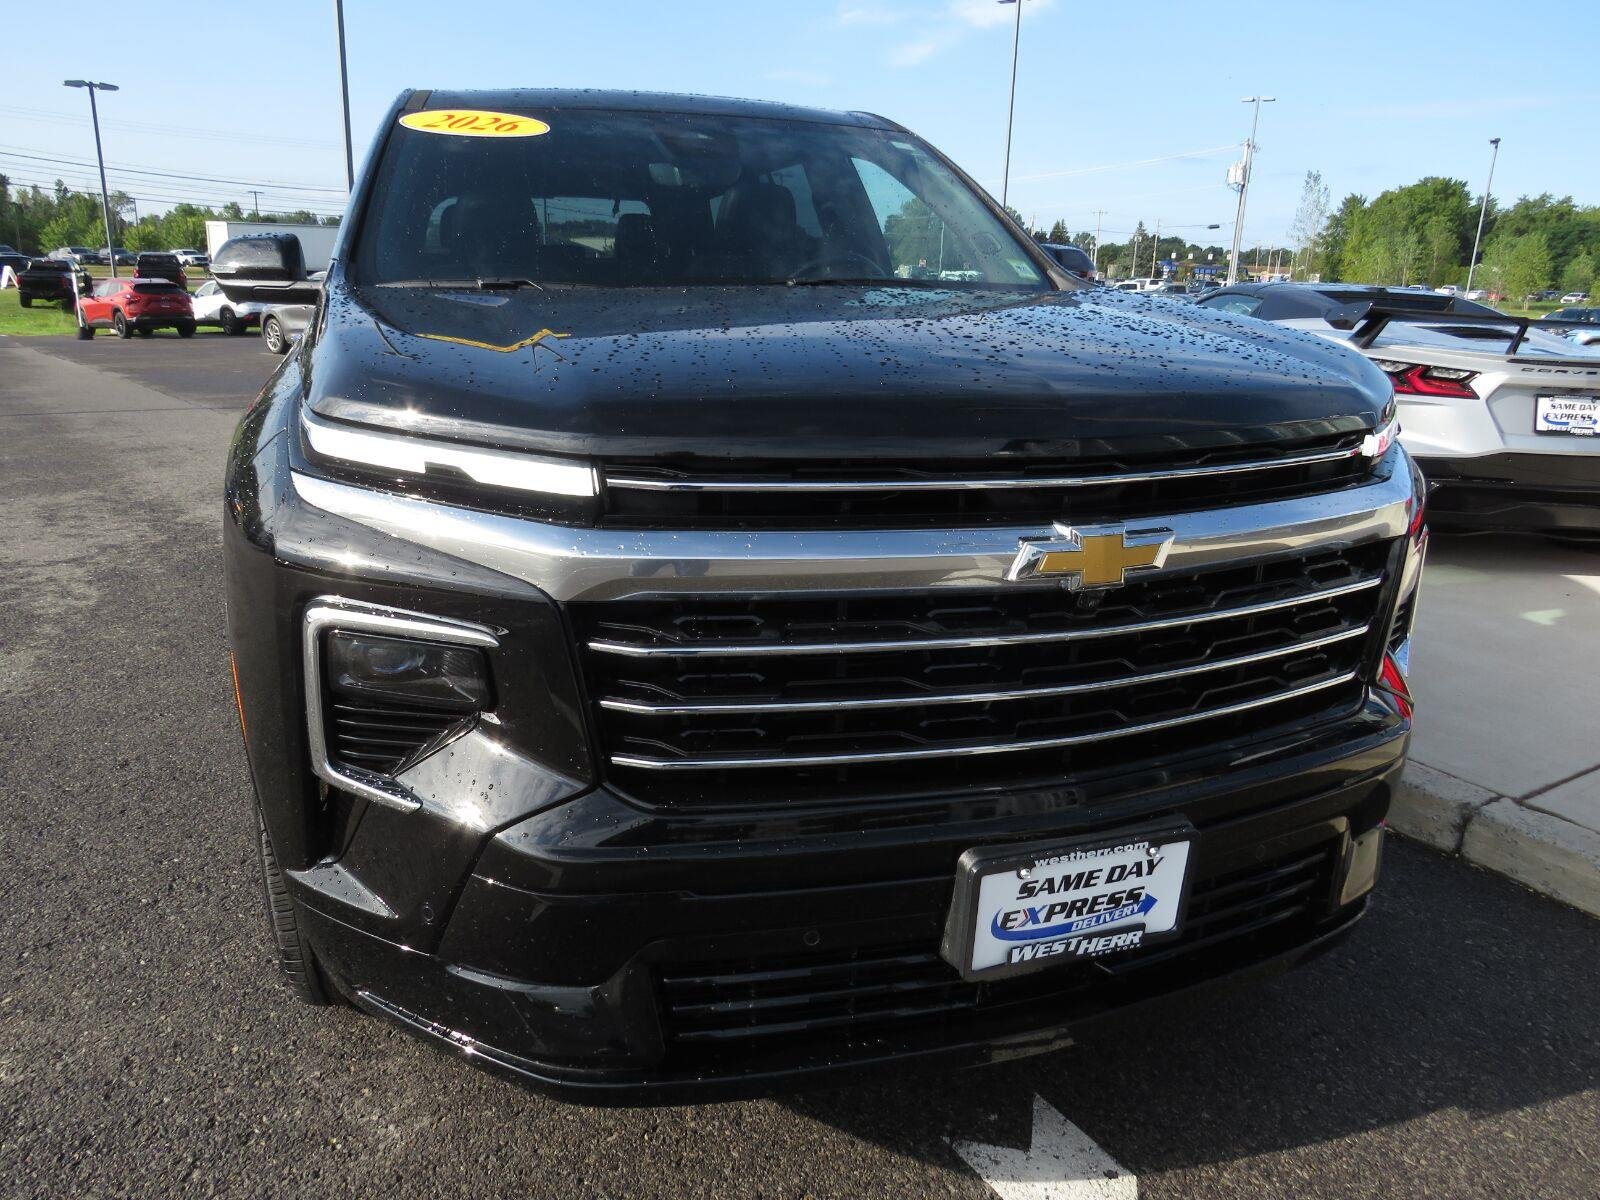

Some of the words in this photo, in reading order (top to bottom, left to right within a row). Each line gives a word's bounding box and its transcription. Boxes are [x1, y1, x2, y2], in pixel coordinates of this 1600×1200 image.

[422, 114, 529, 132] 2026
[1545, 412, 1594, 421] EXPRESS
[1034, 841, 1150, 868] westherr.com
[1016, 868, 1103, 900] SAME
[1104, 856, 1164, 885] DAY
[999, 886, 1146, 930] EXPRESS
[1072, 903, 1142, 931] DELIVERY
